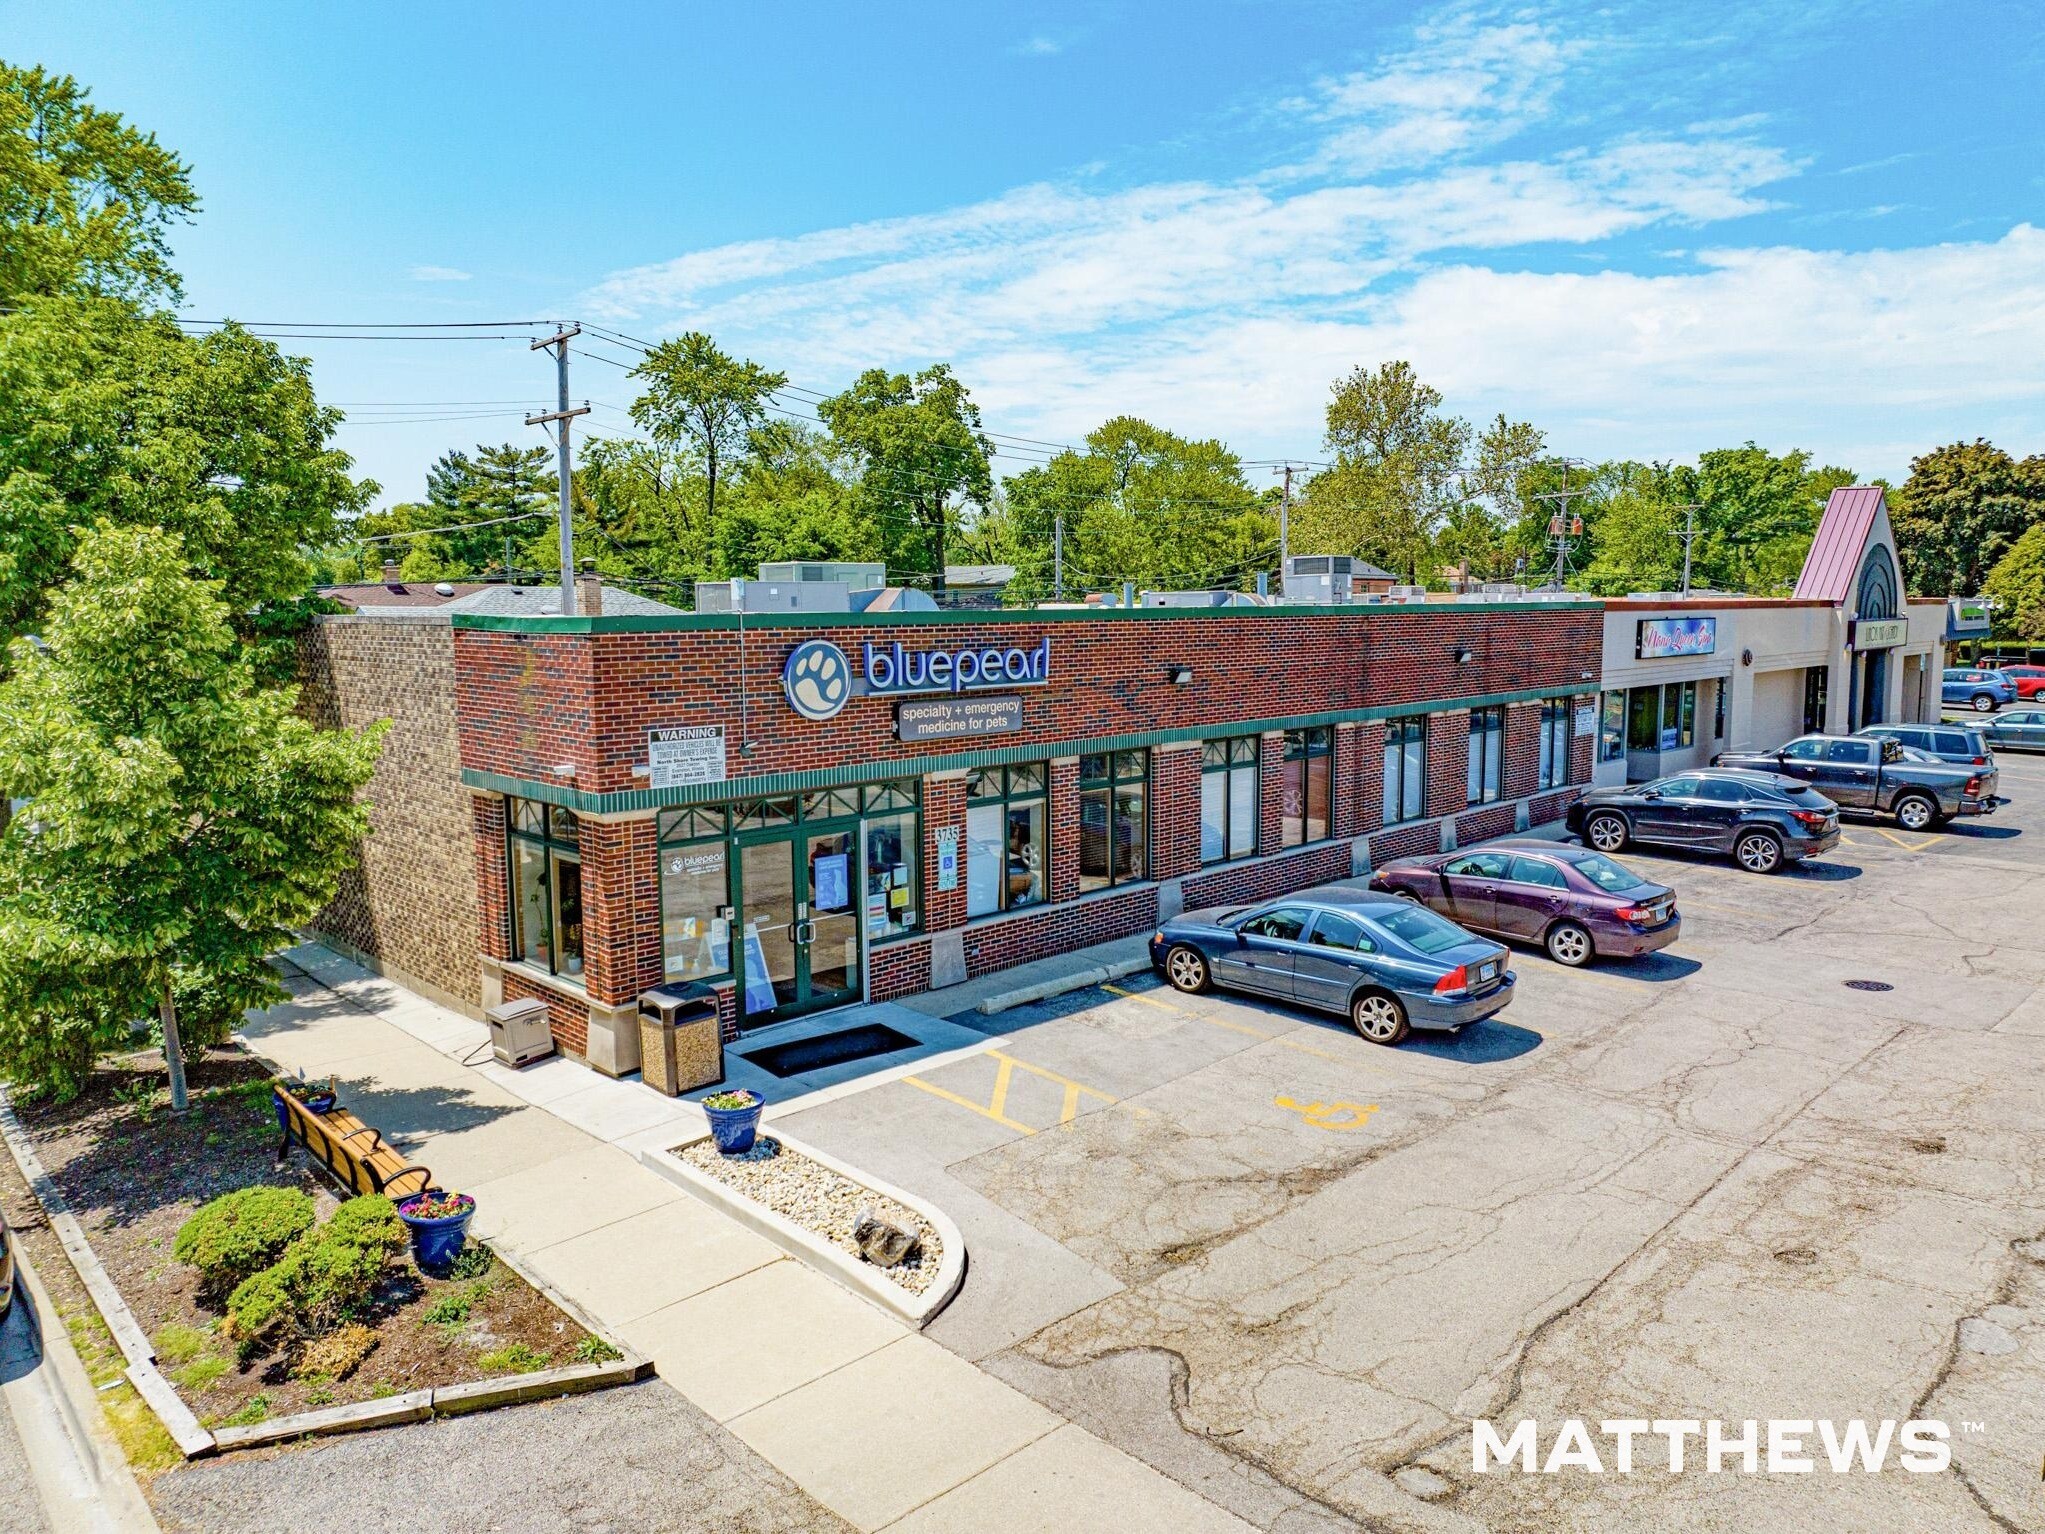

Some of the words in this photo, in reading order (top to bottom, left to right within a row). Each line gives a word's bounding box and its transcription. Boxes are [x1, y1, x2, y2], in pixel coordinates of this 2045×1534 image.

[863, 637, 1050, 693] bluepearl
[902, 704, 952, 722] specialty
[965, 701, 1020, 715] emergency
[918, 720, 966, 734] medicine
[968, 717, 984, 729] for
[986, 716, 1008, 731] pets
[658, 727, 716, 741] WARNING
[686, 740, 704, 749] VEHICLES
[705, 739, 715, 747] WILL
[657, 751, 672, 759] TOWED
[680, 748, 698, 756] OWNER'S
[699, 747, 717, 755] EXPENSE
[937, 826, 958, 842] 3735
[684, 851, 725, 865] bluepearl
